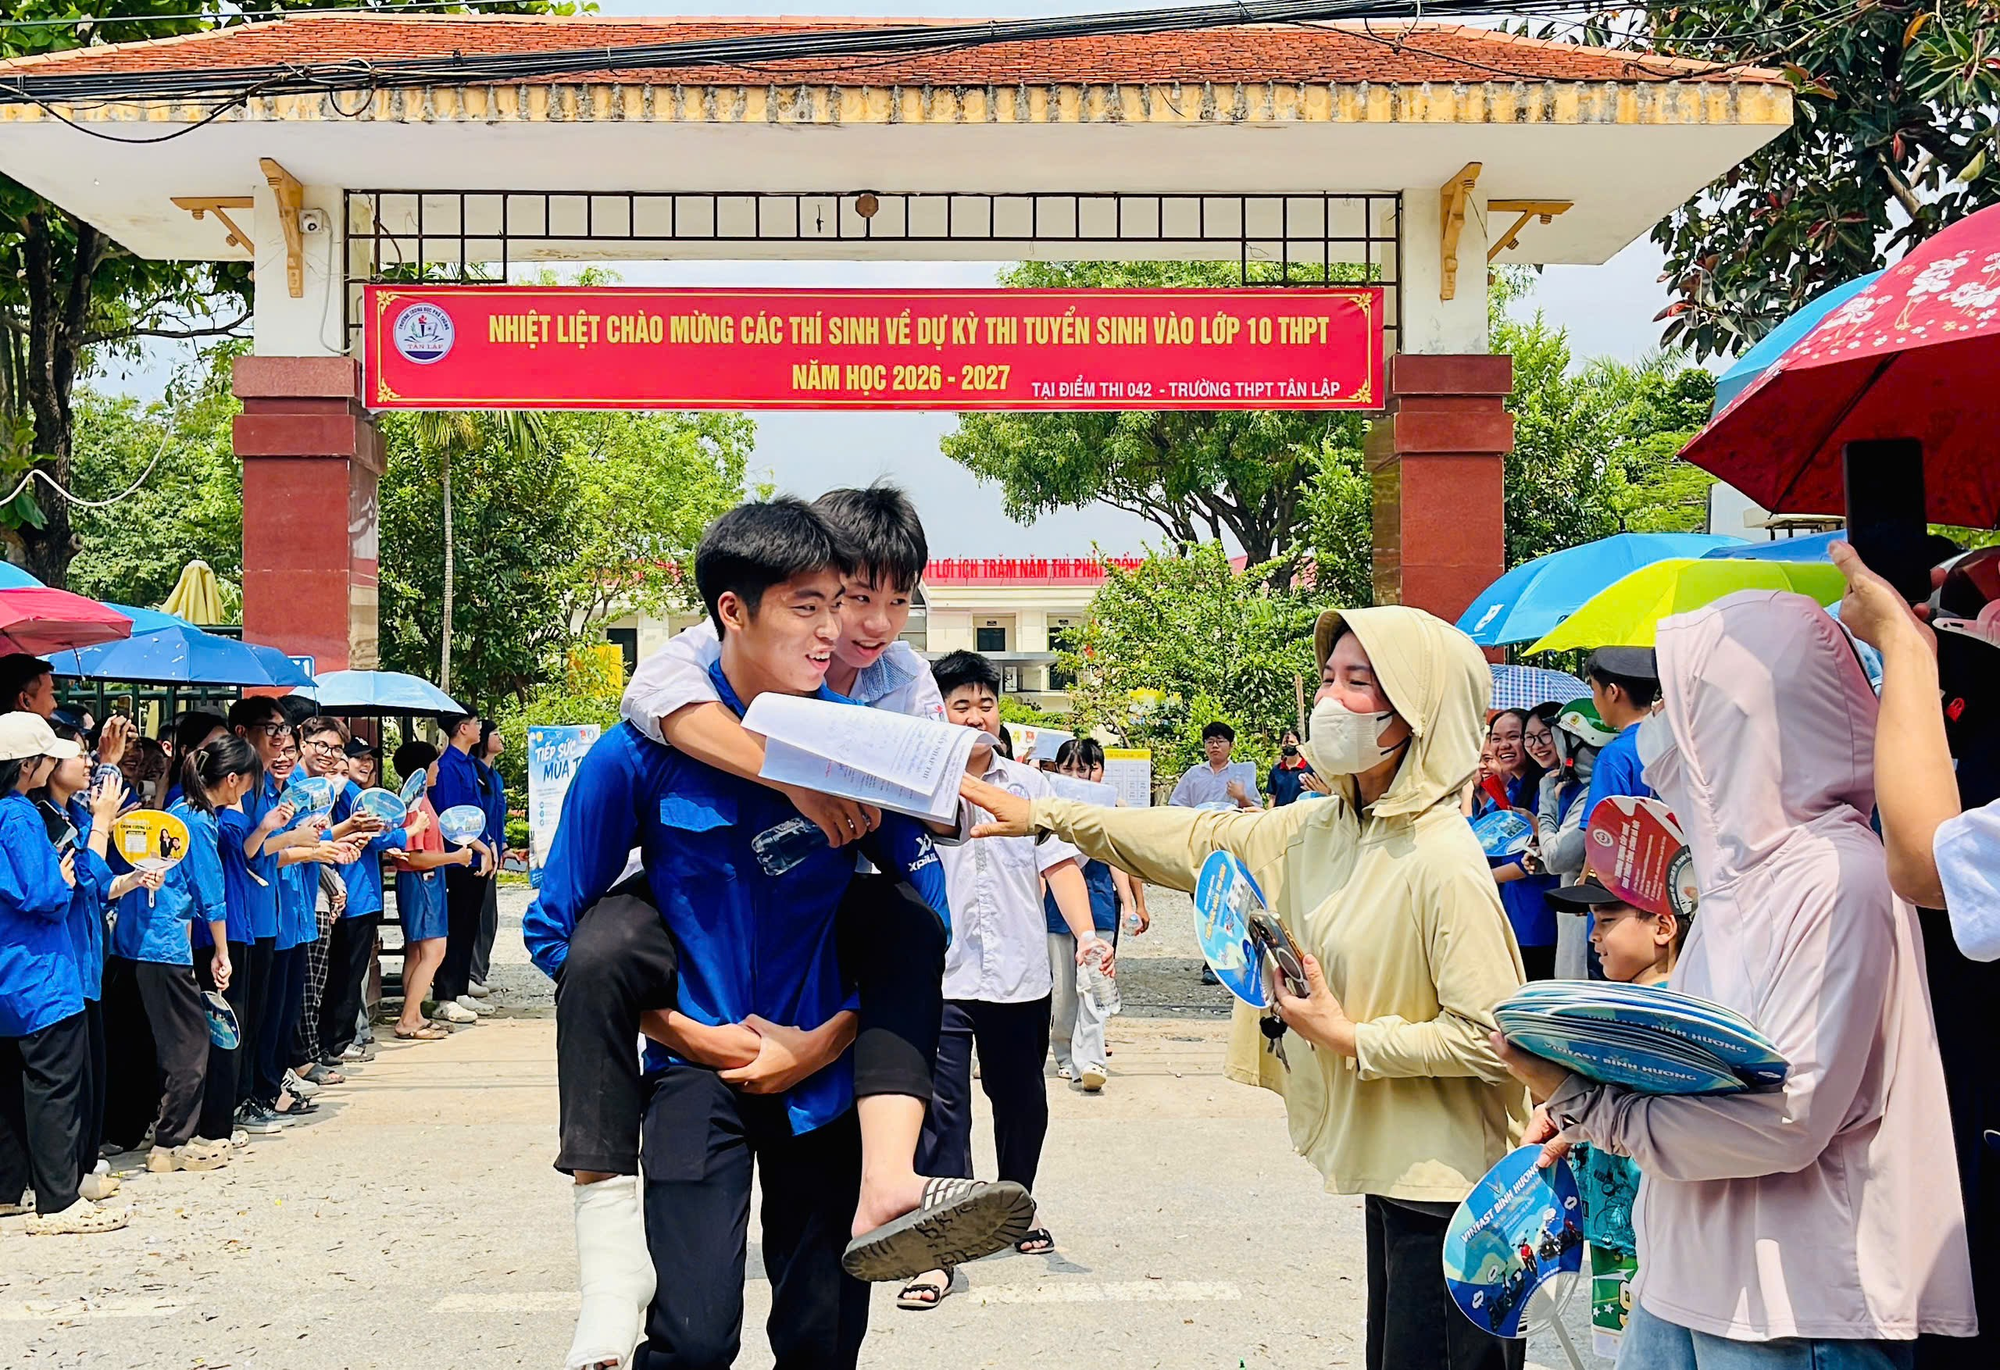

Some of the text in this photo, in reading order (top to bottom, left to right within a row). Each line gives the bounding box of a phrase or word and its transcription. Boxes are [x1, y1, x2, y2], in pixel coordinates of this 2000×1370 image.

[489, 306, 1330, 351] NHIỆT LIỆT CHÀO MỪNG CÁC THÍ SINH VỀ DỰ KỲ THI TUYỂN SINH VÀO LỚP 10 THPT
[793, 359, 839, 391] NĂM
[847, 365, 886, 396] HỌC
[893, 365, 941, 390] 2026
[962, 365, 1010, 390] 2027
[1032, 382, 1055, 400] TẠI
[1059, 374, 1095, 397] ĐIỂM
[1100, 383, 1123, 397] THI
[1128, 383, 1152, 397] 042
[1169, 378, 1231, 398] TRƯỜNG
[1235, 382, 1274, 397] THPT
[1279, 377, 1307, 397] TÂN
[1311, 377, 1341, 401] LẬP
[958, 553, 978, 578] ÍCH
[982, 553, 1017, 578] TRĂM
[1019, 553, 1047, 578] NĂM
[1051, 553, 1070, 578] THÌ
[534, 740, 557, 764] TIẾP
[557, 737, 577, 760] SỨC
[543, 757, 570, 783] MÙA
[1460, 1206, 1495, 1244] VINFAST
[1493, 1187, 1515, 1214] BÌNH
